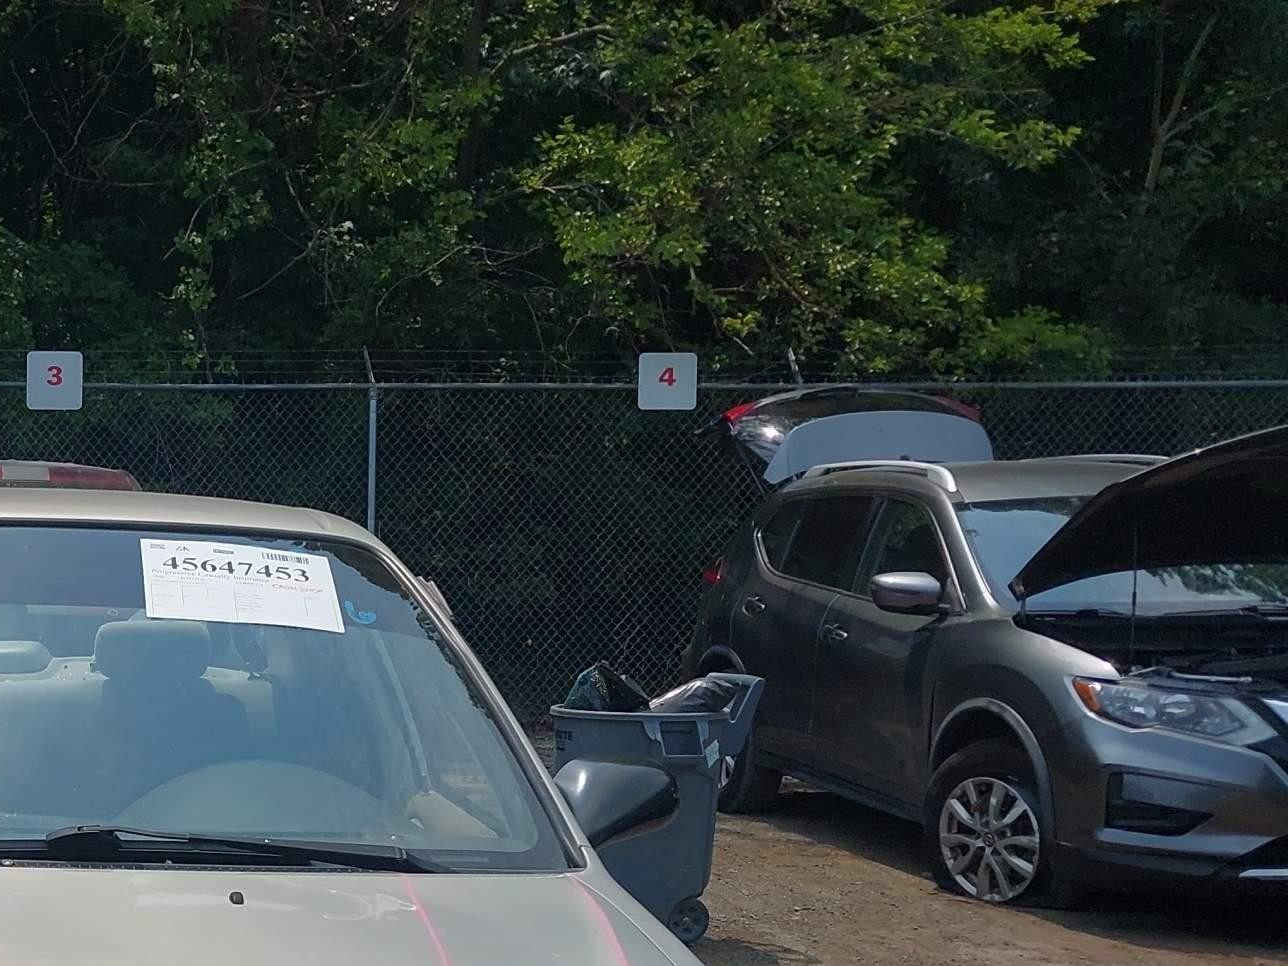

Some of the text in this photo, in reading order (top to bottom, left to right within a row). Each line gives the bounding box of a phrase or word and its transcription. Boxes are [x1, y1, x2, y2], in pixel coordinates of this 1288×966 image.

[46, 365, 63, 386] 3
[658, 367, 677, 386] 4
[162, 556, 310, 583] 45647453
